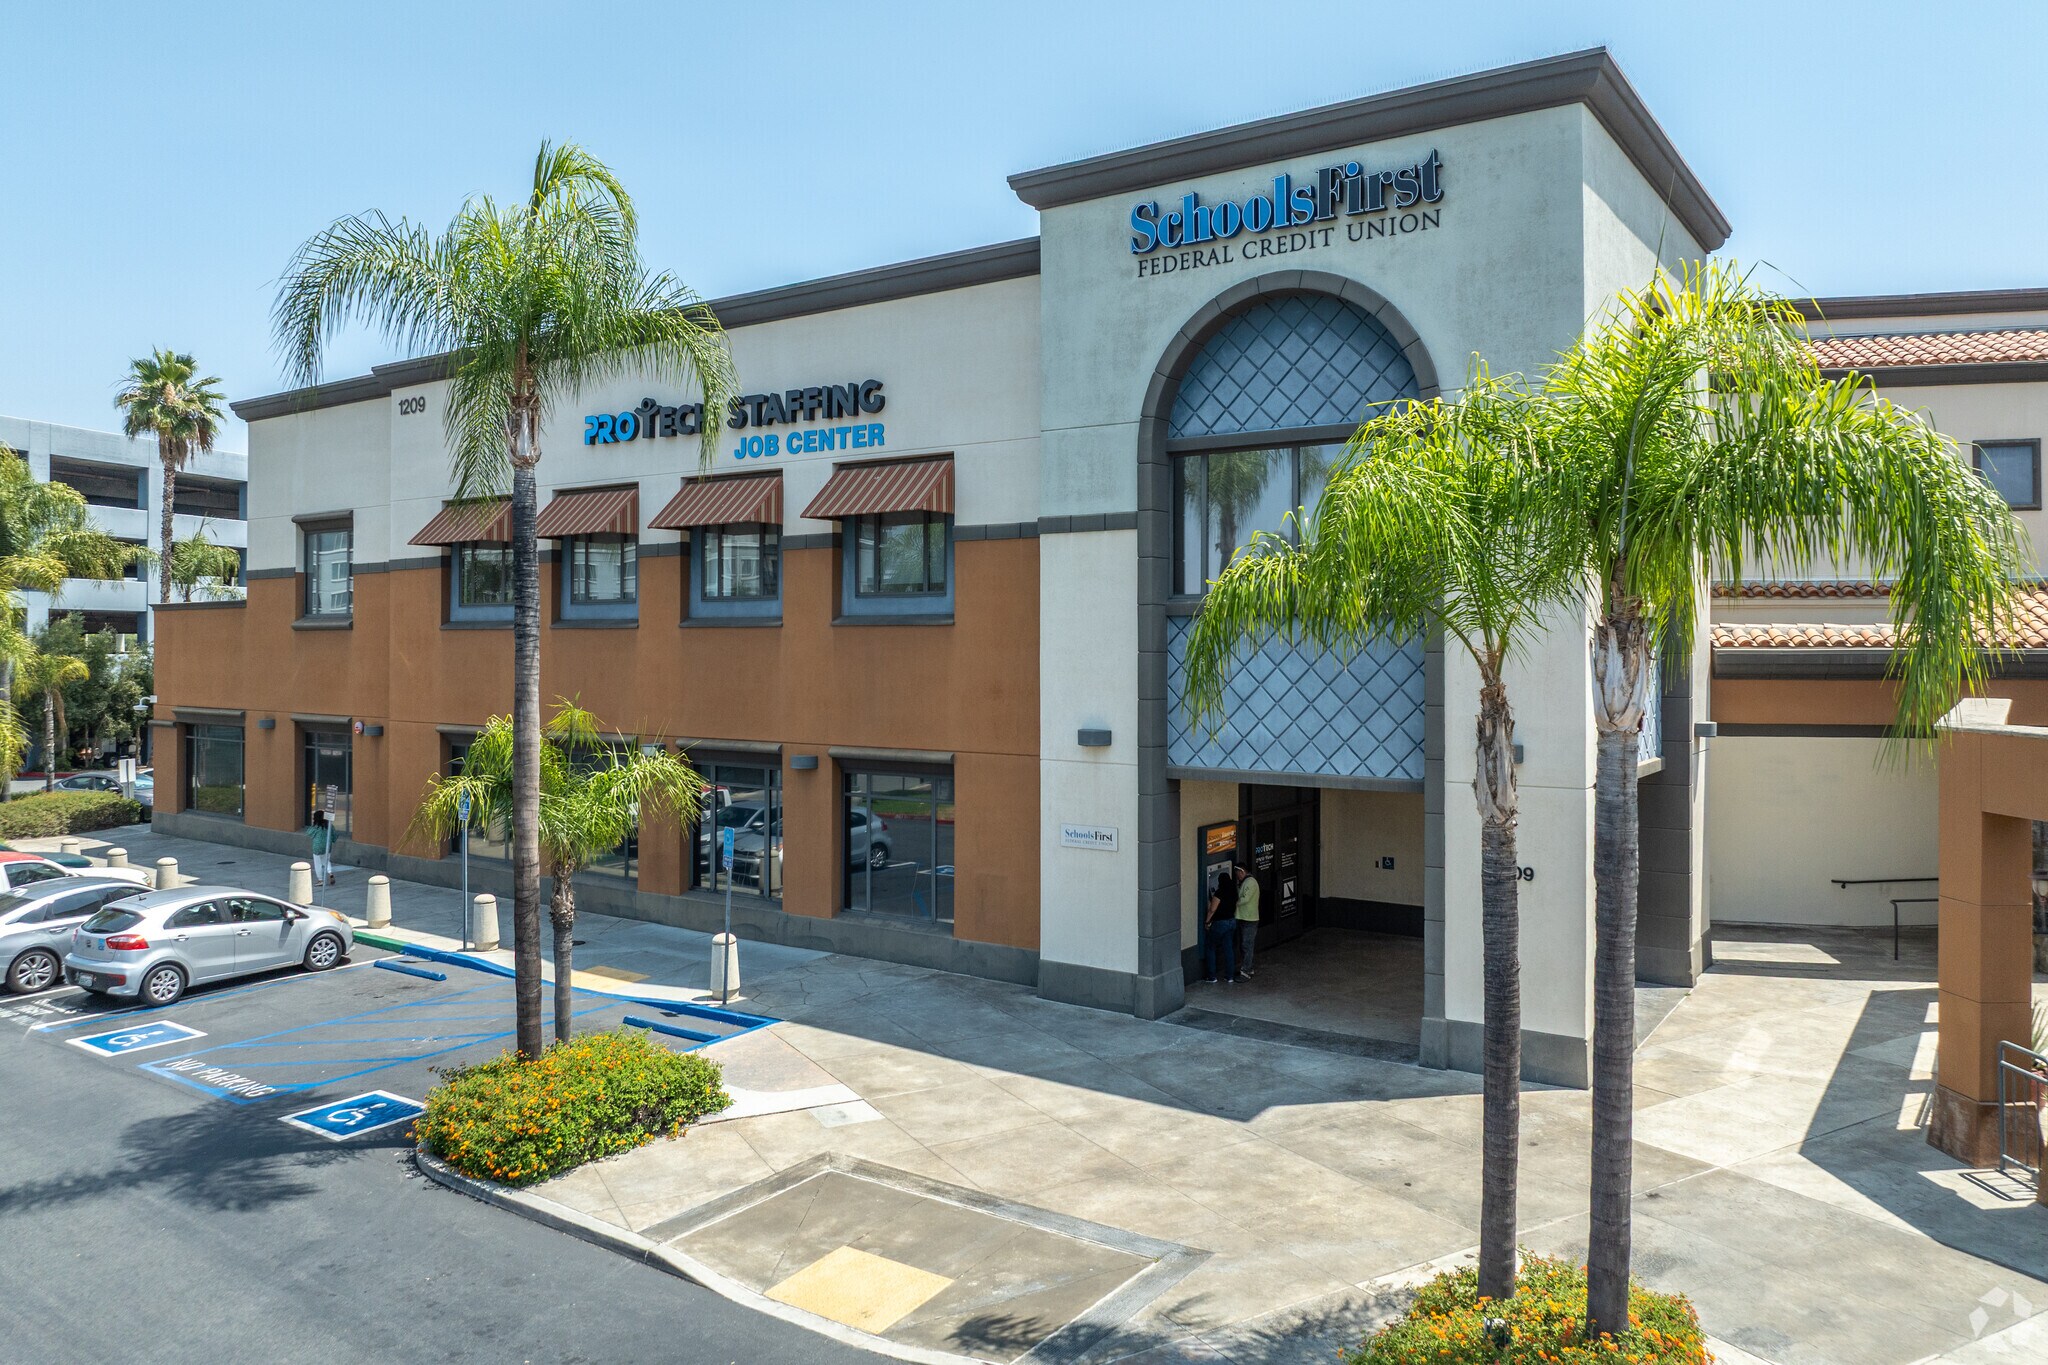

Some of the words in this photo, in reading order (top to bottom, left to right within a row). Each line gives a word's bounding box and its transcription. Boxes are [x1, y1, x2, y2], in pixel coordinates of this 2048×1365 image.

[1130, 148, 1445, 255] SchoolsFirst
[1137, 245, 1234, 278] FEDERAL
[1242, 227, 1335, 260] CREDIT
[1346, 208, 1442, 243] UNION
[398, 396, 426, 416] 1209
[726, 379, 886, 429] STAFFING
[733, 435, 780, 460] JOB
[786, 423, 886, 453] CENTER
[1065, 829, 1113, 841] SchoolsFirst
[165, 1058, 206, 1071] NO
[192, 1067, 277, 1097] PARKING
